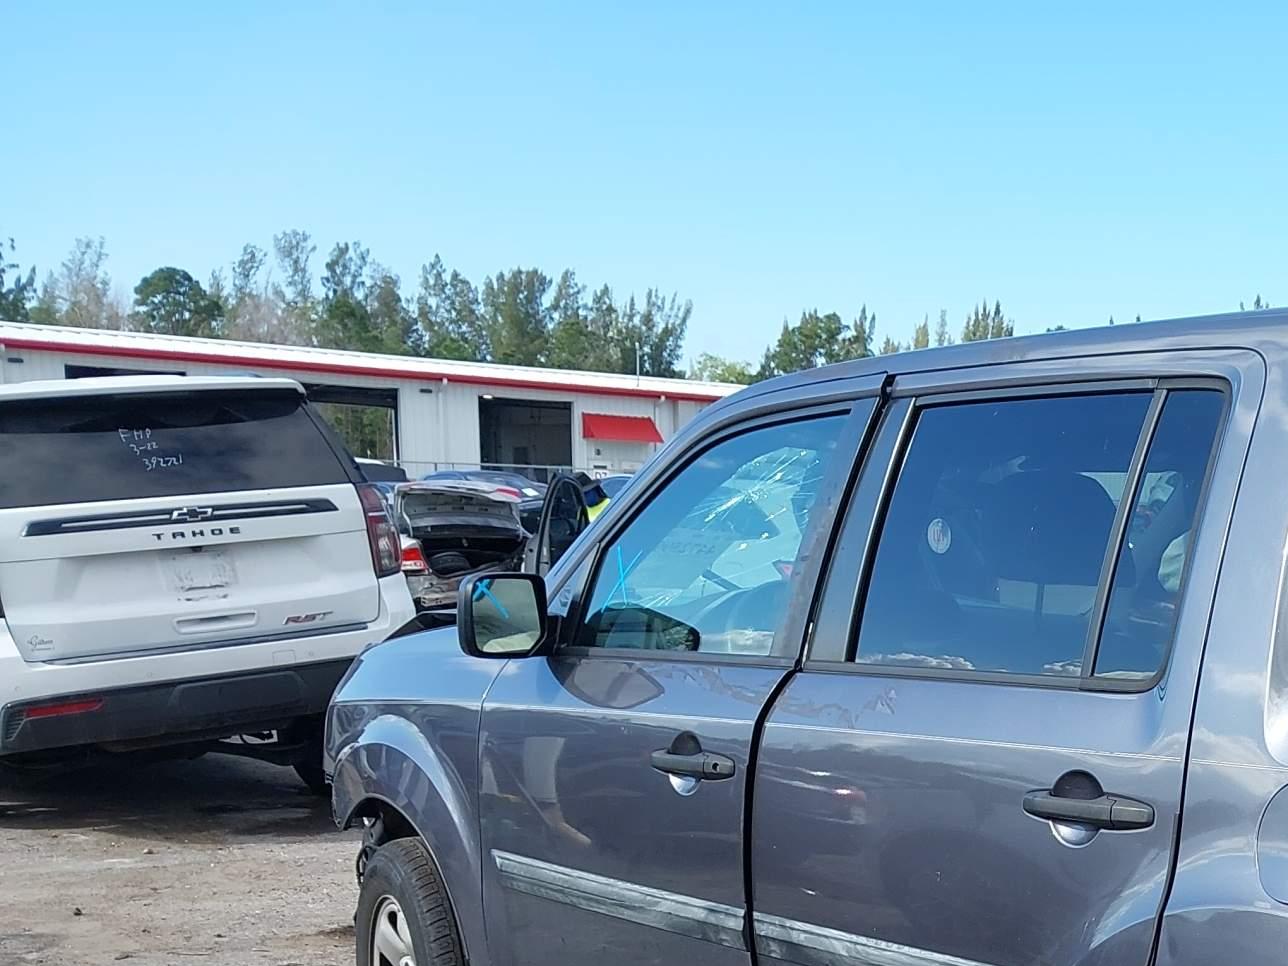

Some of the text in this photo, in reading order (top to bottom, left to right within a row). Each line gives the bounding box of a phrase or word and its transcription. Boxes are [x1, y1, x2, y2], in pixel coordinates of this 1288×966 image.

[129, 441, 159, 456] 3-22
[151, 526, 241, 540] TAHOE
[281, 610, 334, 626] RST
